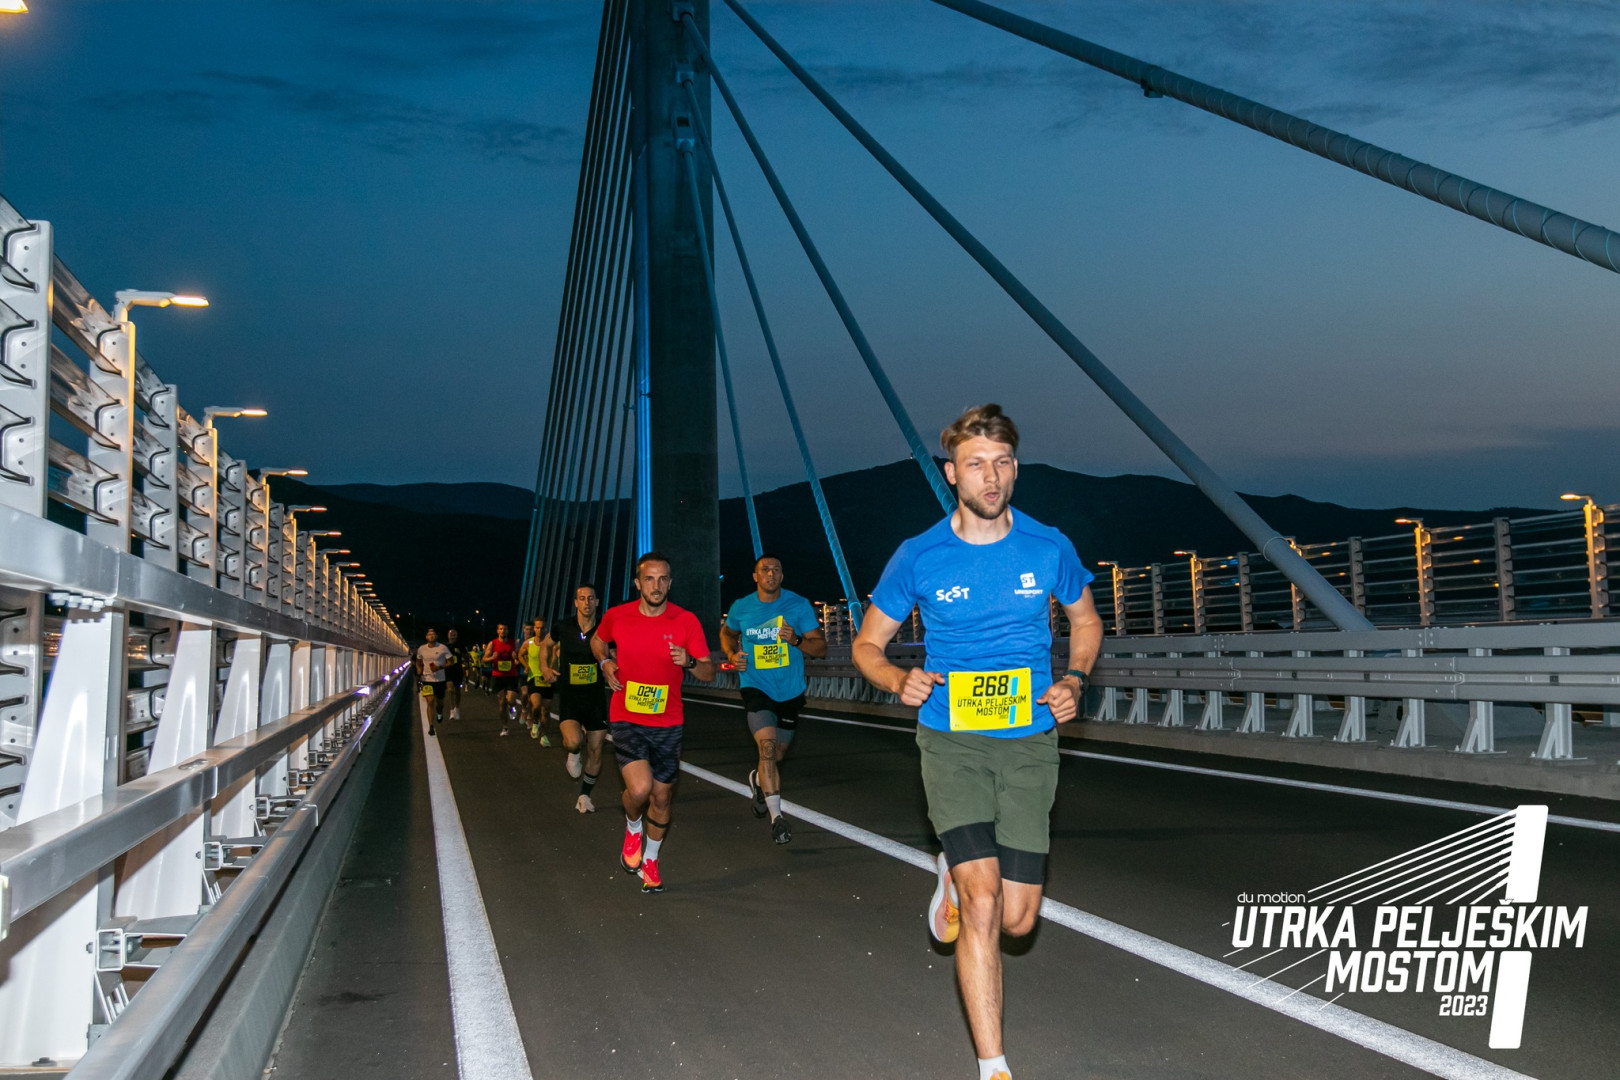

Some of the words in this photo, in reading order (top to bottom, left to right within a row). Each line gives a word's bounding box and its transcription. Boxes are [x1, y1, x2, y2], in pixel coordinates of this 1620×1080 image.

[936, 586, 970, 603] SCST
[763, 645, 778, 655] 322
[637, 685, 657, 697] 024
[973, 675, 1009, 697] 268
[957, 698, 983, 708] UTRKA
[976, 706, 1010, 716] MOSTOM
